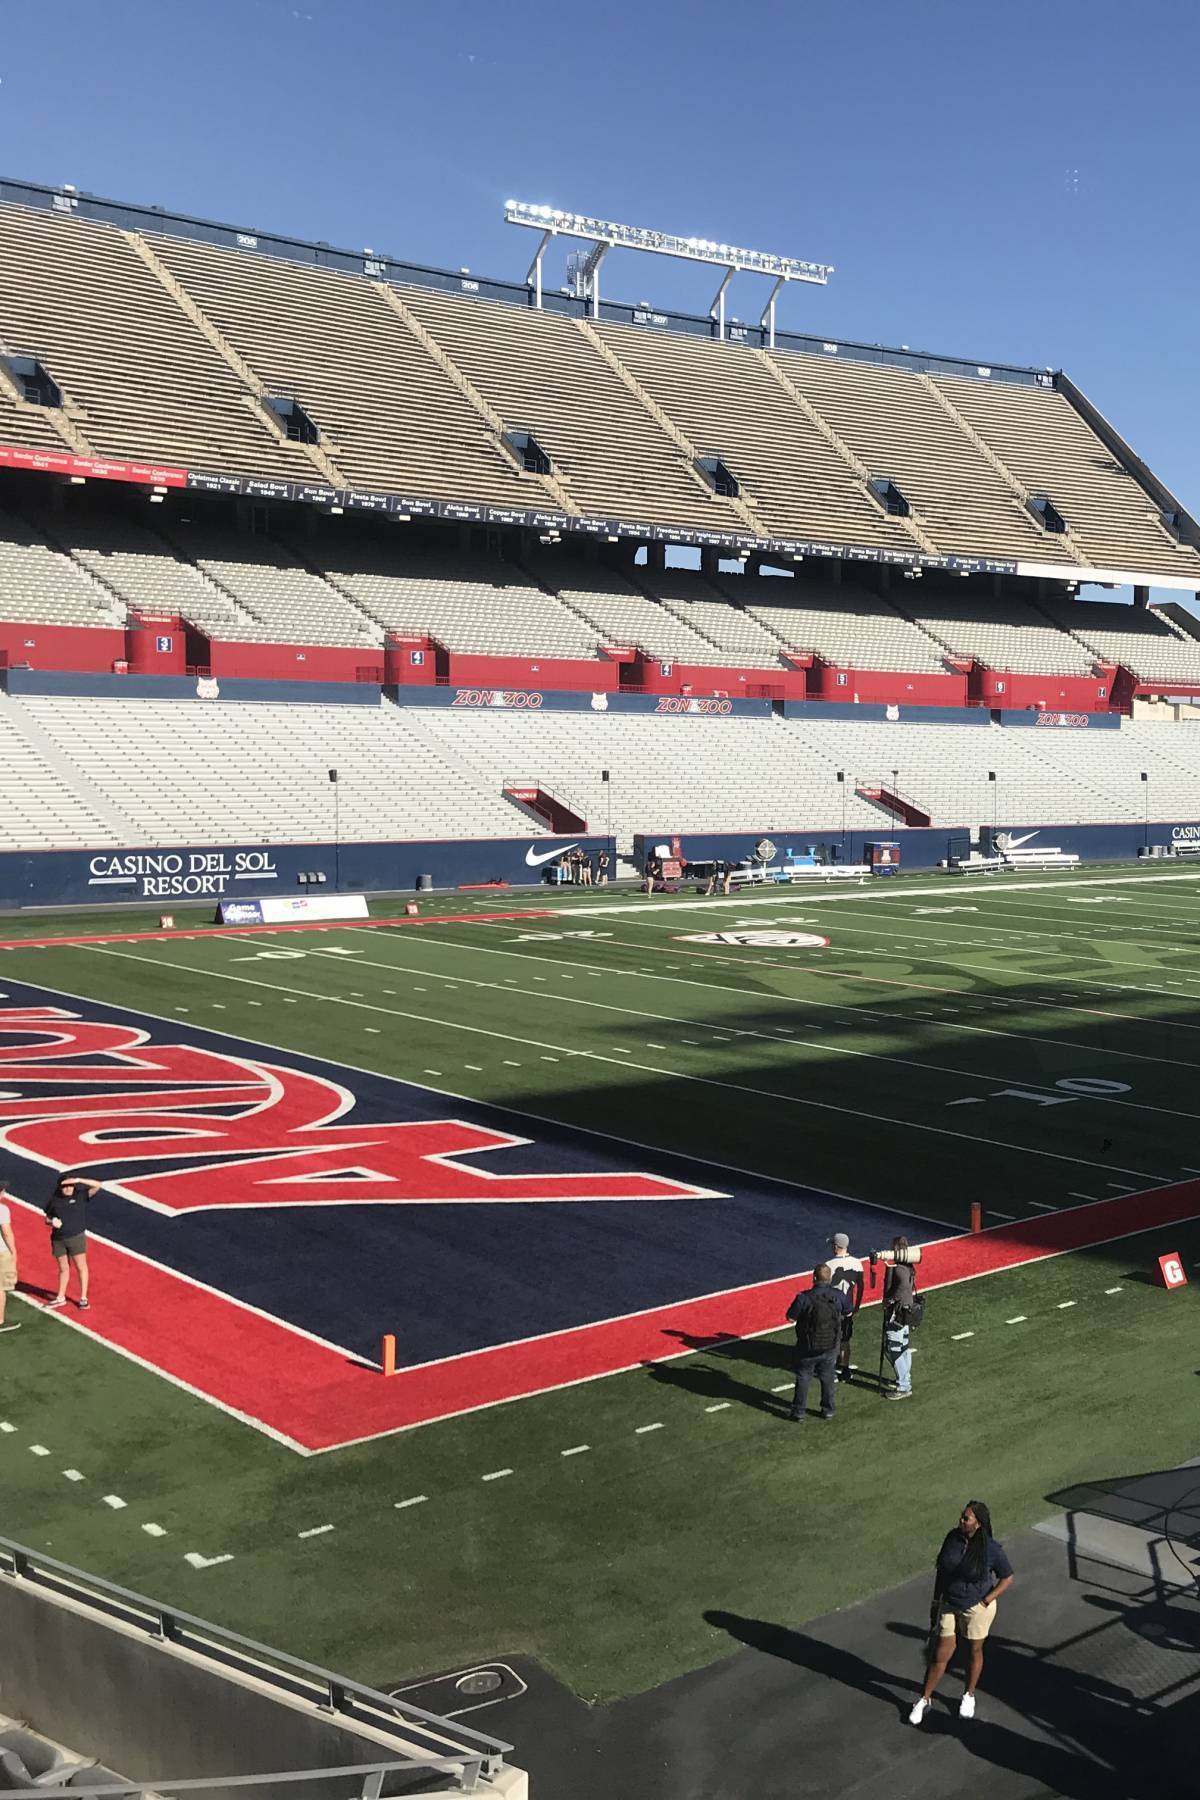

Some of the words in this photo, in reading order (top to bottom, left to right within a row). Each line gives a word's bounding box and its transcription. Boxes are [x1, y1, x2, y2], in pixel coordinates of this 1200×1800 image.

[188, 473, 218, 483] Christmas
[220, 477, 240, 486] Classic
[248, 481, 269, 490] Salad
[270, 483, 288, 491] Bowl
[304, 488, 316, 496] Sun
[318, 489, 336, 497] Bowl
[350, 493, 369, 502] Fiesta
[415, 500, 431, 508] Bowl
[160, 638, 168, 648] 3
[414, 652, 421, 660] 4
[89, 854, 183, 876] CASINO
[189, 853, 232, 873] DEL
[235, 852, 276, 872] SOL
[143, 874, 229, 896] RESORT
[230, 903, 254, 913] Game
[988, 1077, 1134, 1106] 10
[1164, 1260, 1184, 1284] G
